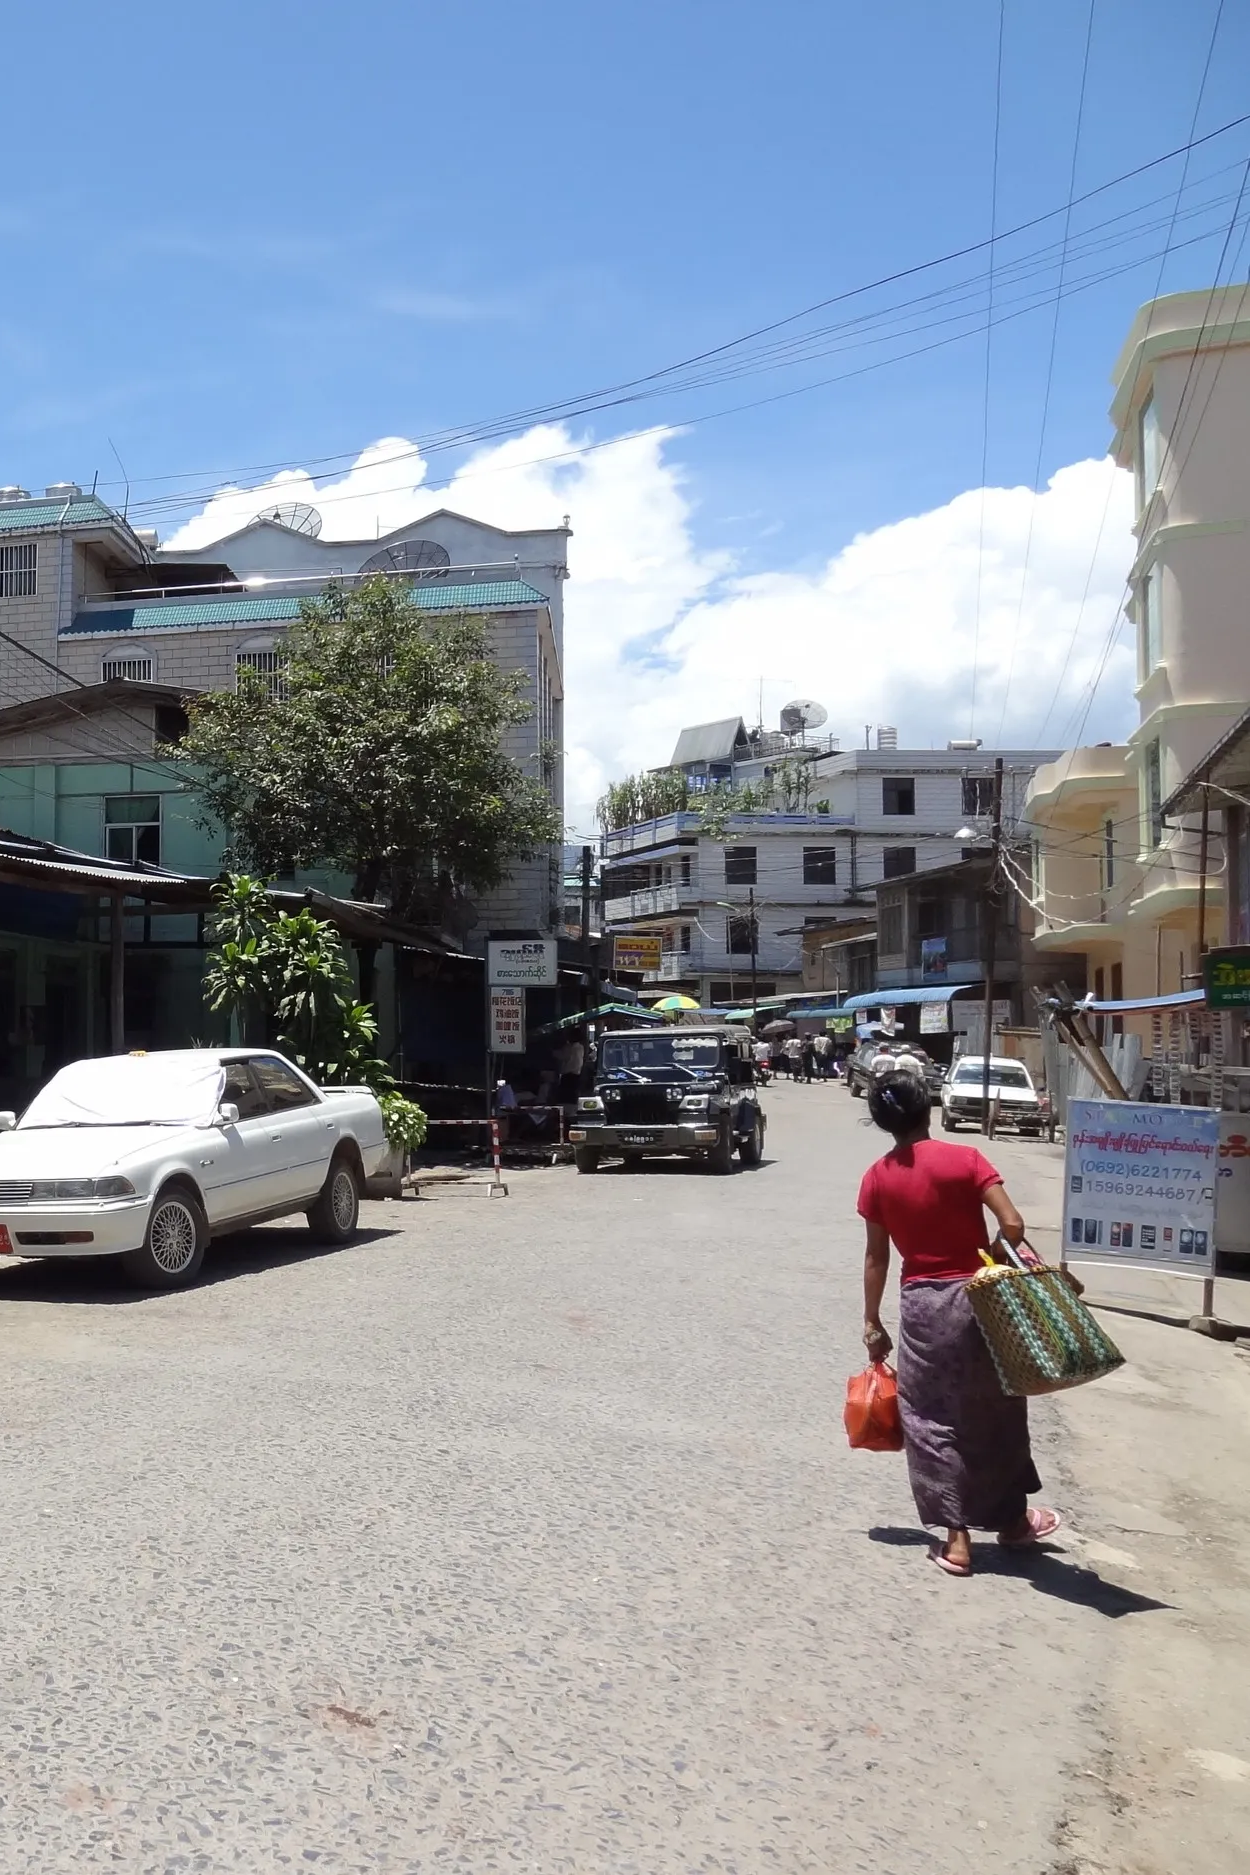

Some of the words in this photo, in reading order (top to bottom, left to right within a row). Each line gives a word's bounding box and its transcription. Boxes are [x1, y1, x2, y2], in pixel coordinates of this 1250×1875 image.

[496, 965, 548, 981] စားသောက်ဆိုင်
[1080, 1159, 1202, 1182] (0692)6221774
